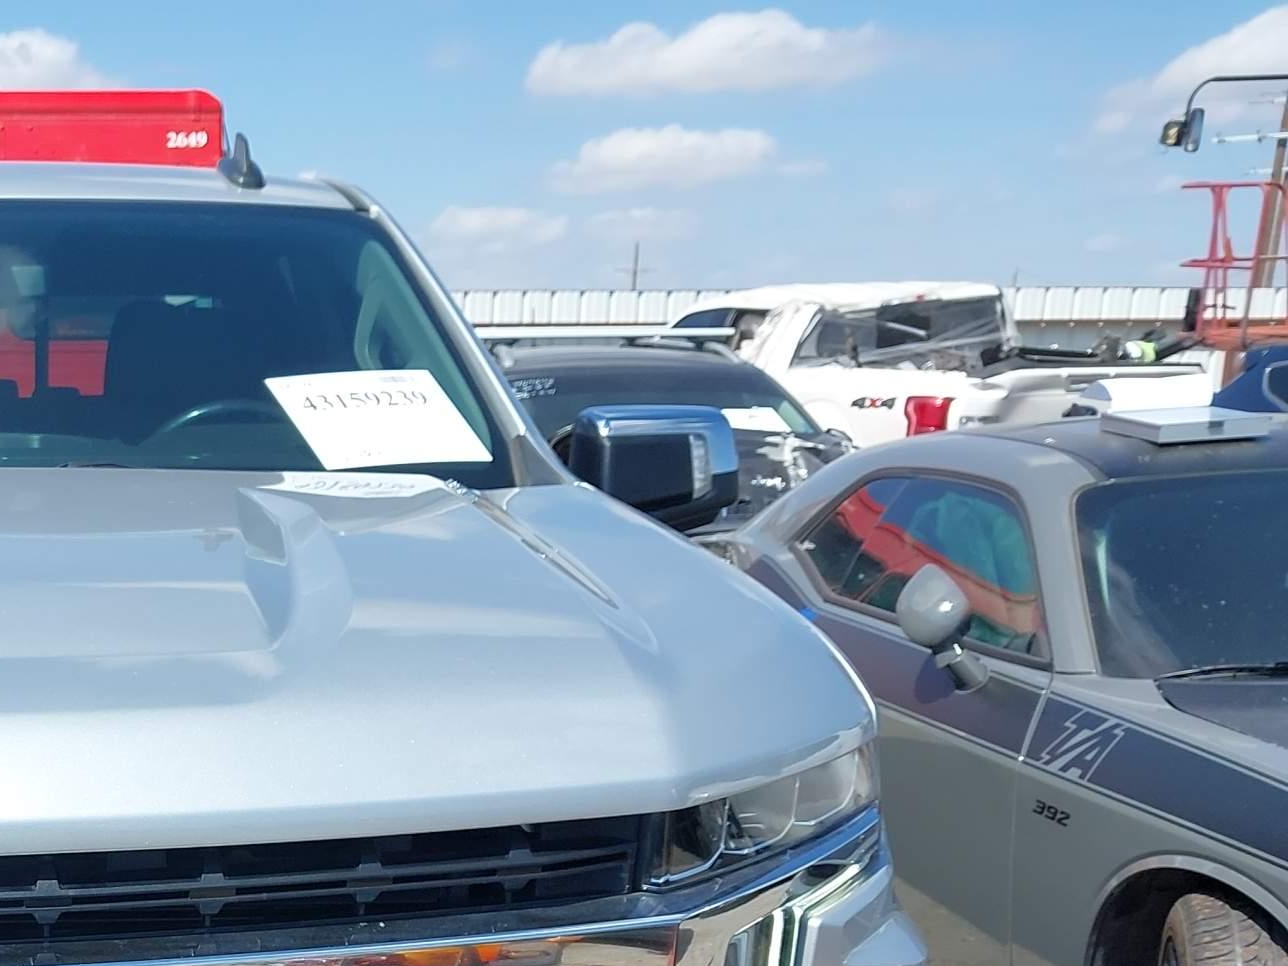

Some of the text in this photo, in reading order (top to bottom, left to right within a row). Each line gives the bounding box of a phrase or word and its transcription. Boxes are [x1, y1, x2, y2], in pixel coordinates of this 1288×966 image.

[166, 129, 208, 149] 2649
[303, 389, 428, 411] 43159239
[1032, 799, 1072, 828] 392
